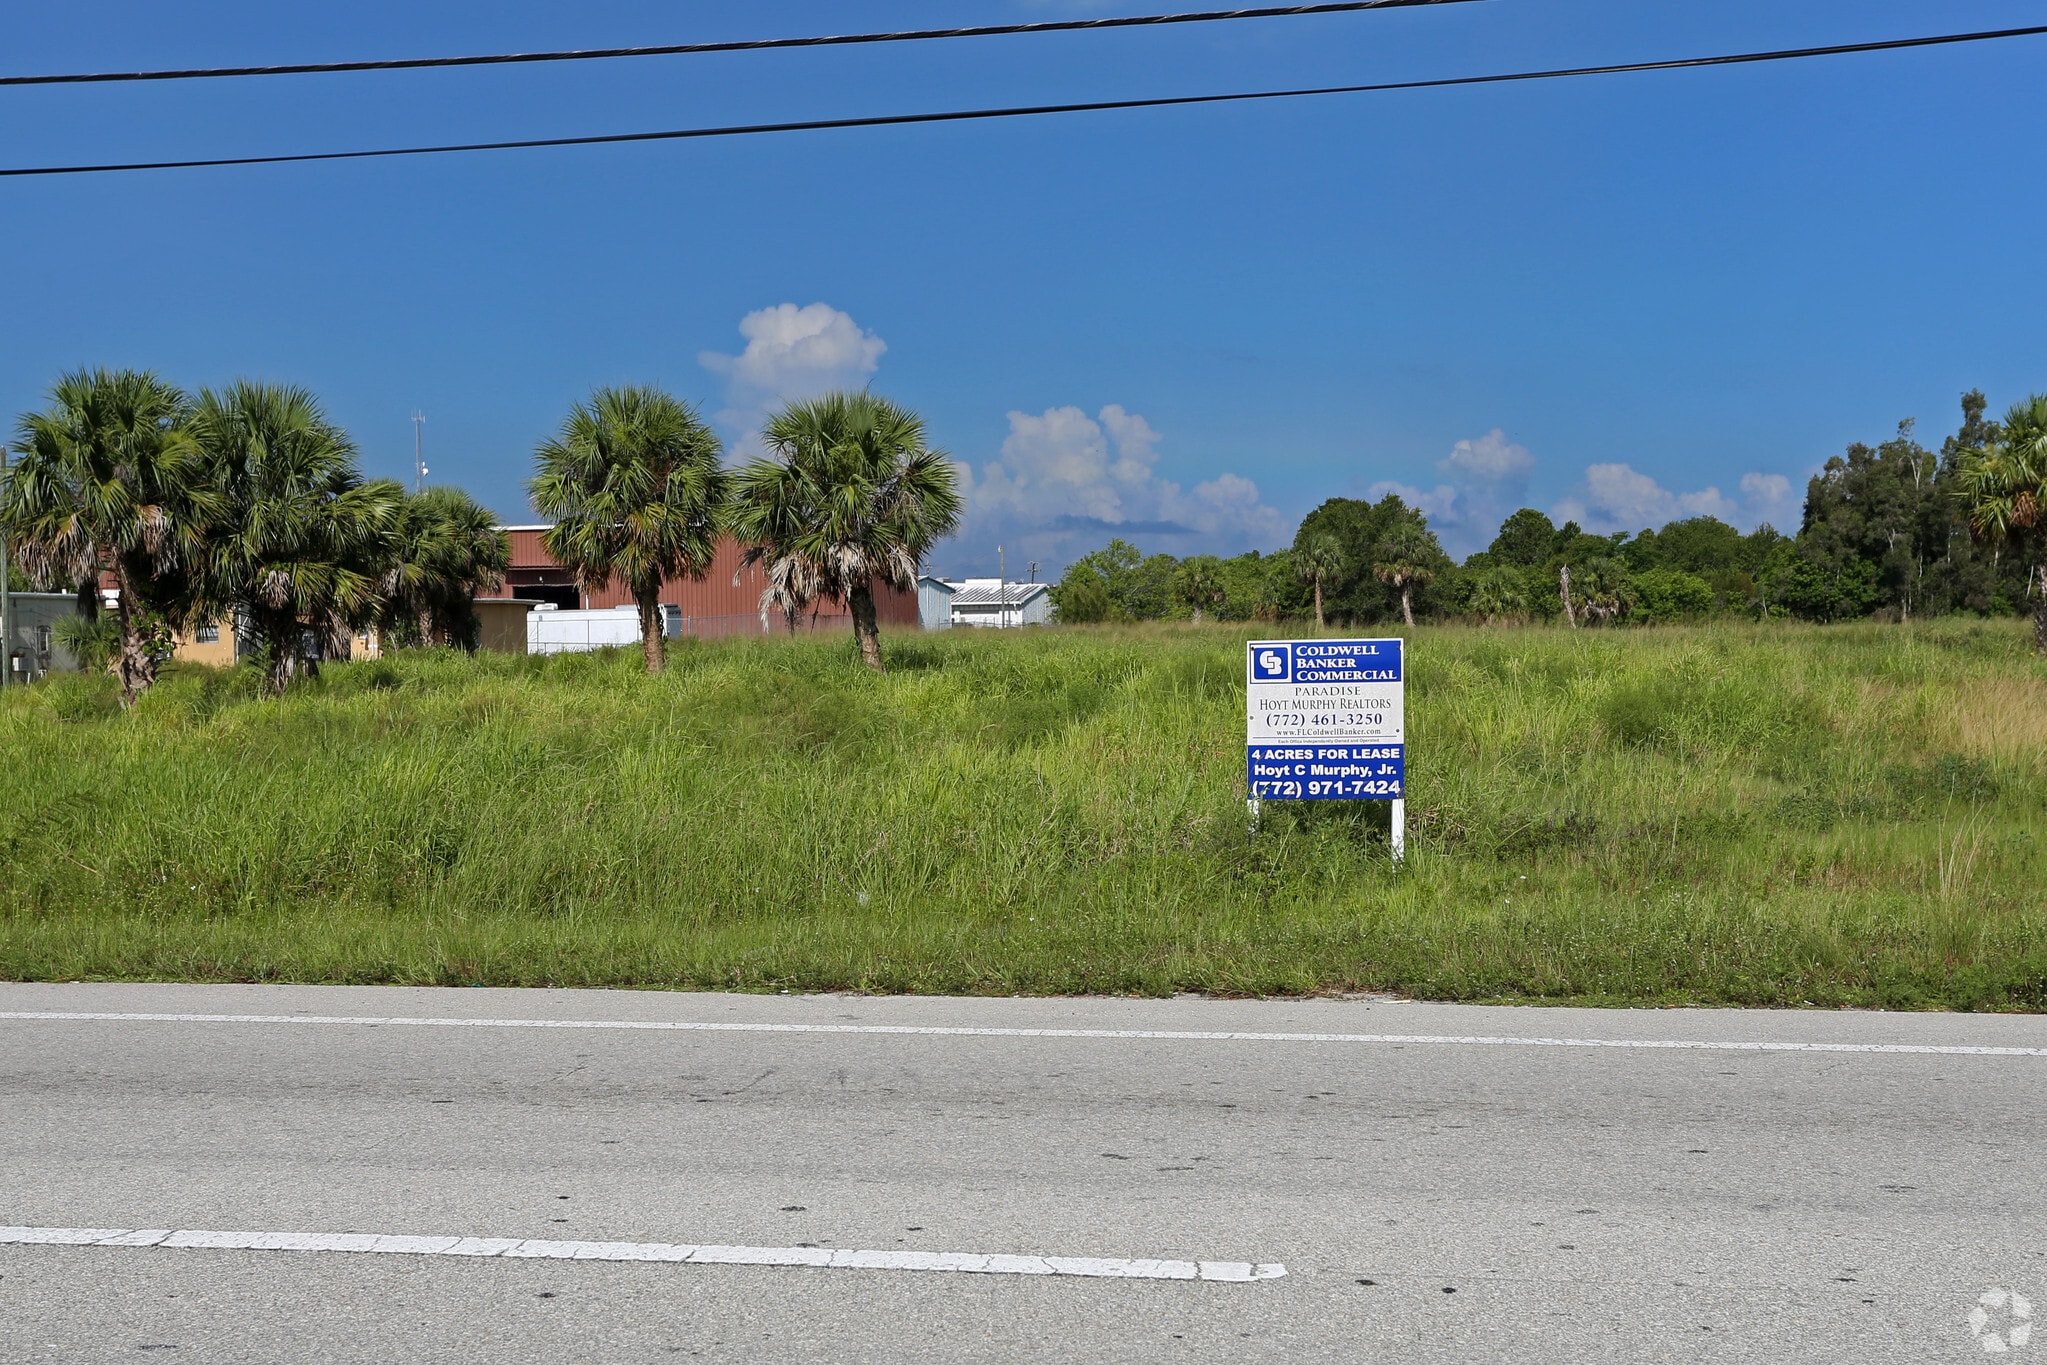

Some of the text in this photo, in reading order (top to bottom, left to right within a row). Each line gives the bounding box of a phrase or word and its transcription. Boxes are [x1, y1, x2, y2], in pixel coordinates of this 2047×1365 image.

[1296, 645, 1379, 657] COLDWELL
[1296, 658, 1357, 669] BANKER
[1296, 670, 1397, 681] COMMERCIAL
[1295, 686, 1361, 696] PARADISE
[1260, 697, 1391, 710] HOYT MURPHY REALTORS
[1266, 712, 1383, 727] (772) 461-3250
[1276, 728, 1381, 736] www.FLColdwellBanker.com
[1251, 748, 1400, 760] 4 ACRES FOR LEASE
[1254, 763, 1397, 778] Hoyt C Murphy, Jr.
[1252, 780, 1400, 798] (772) 971-7424
